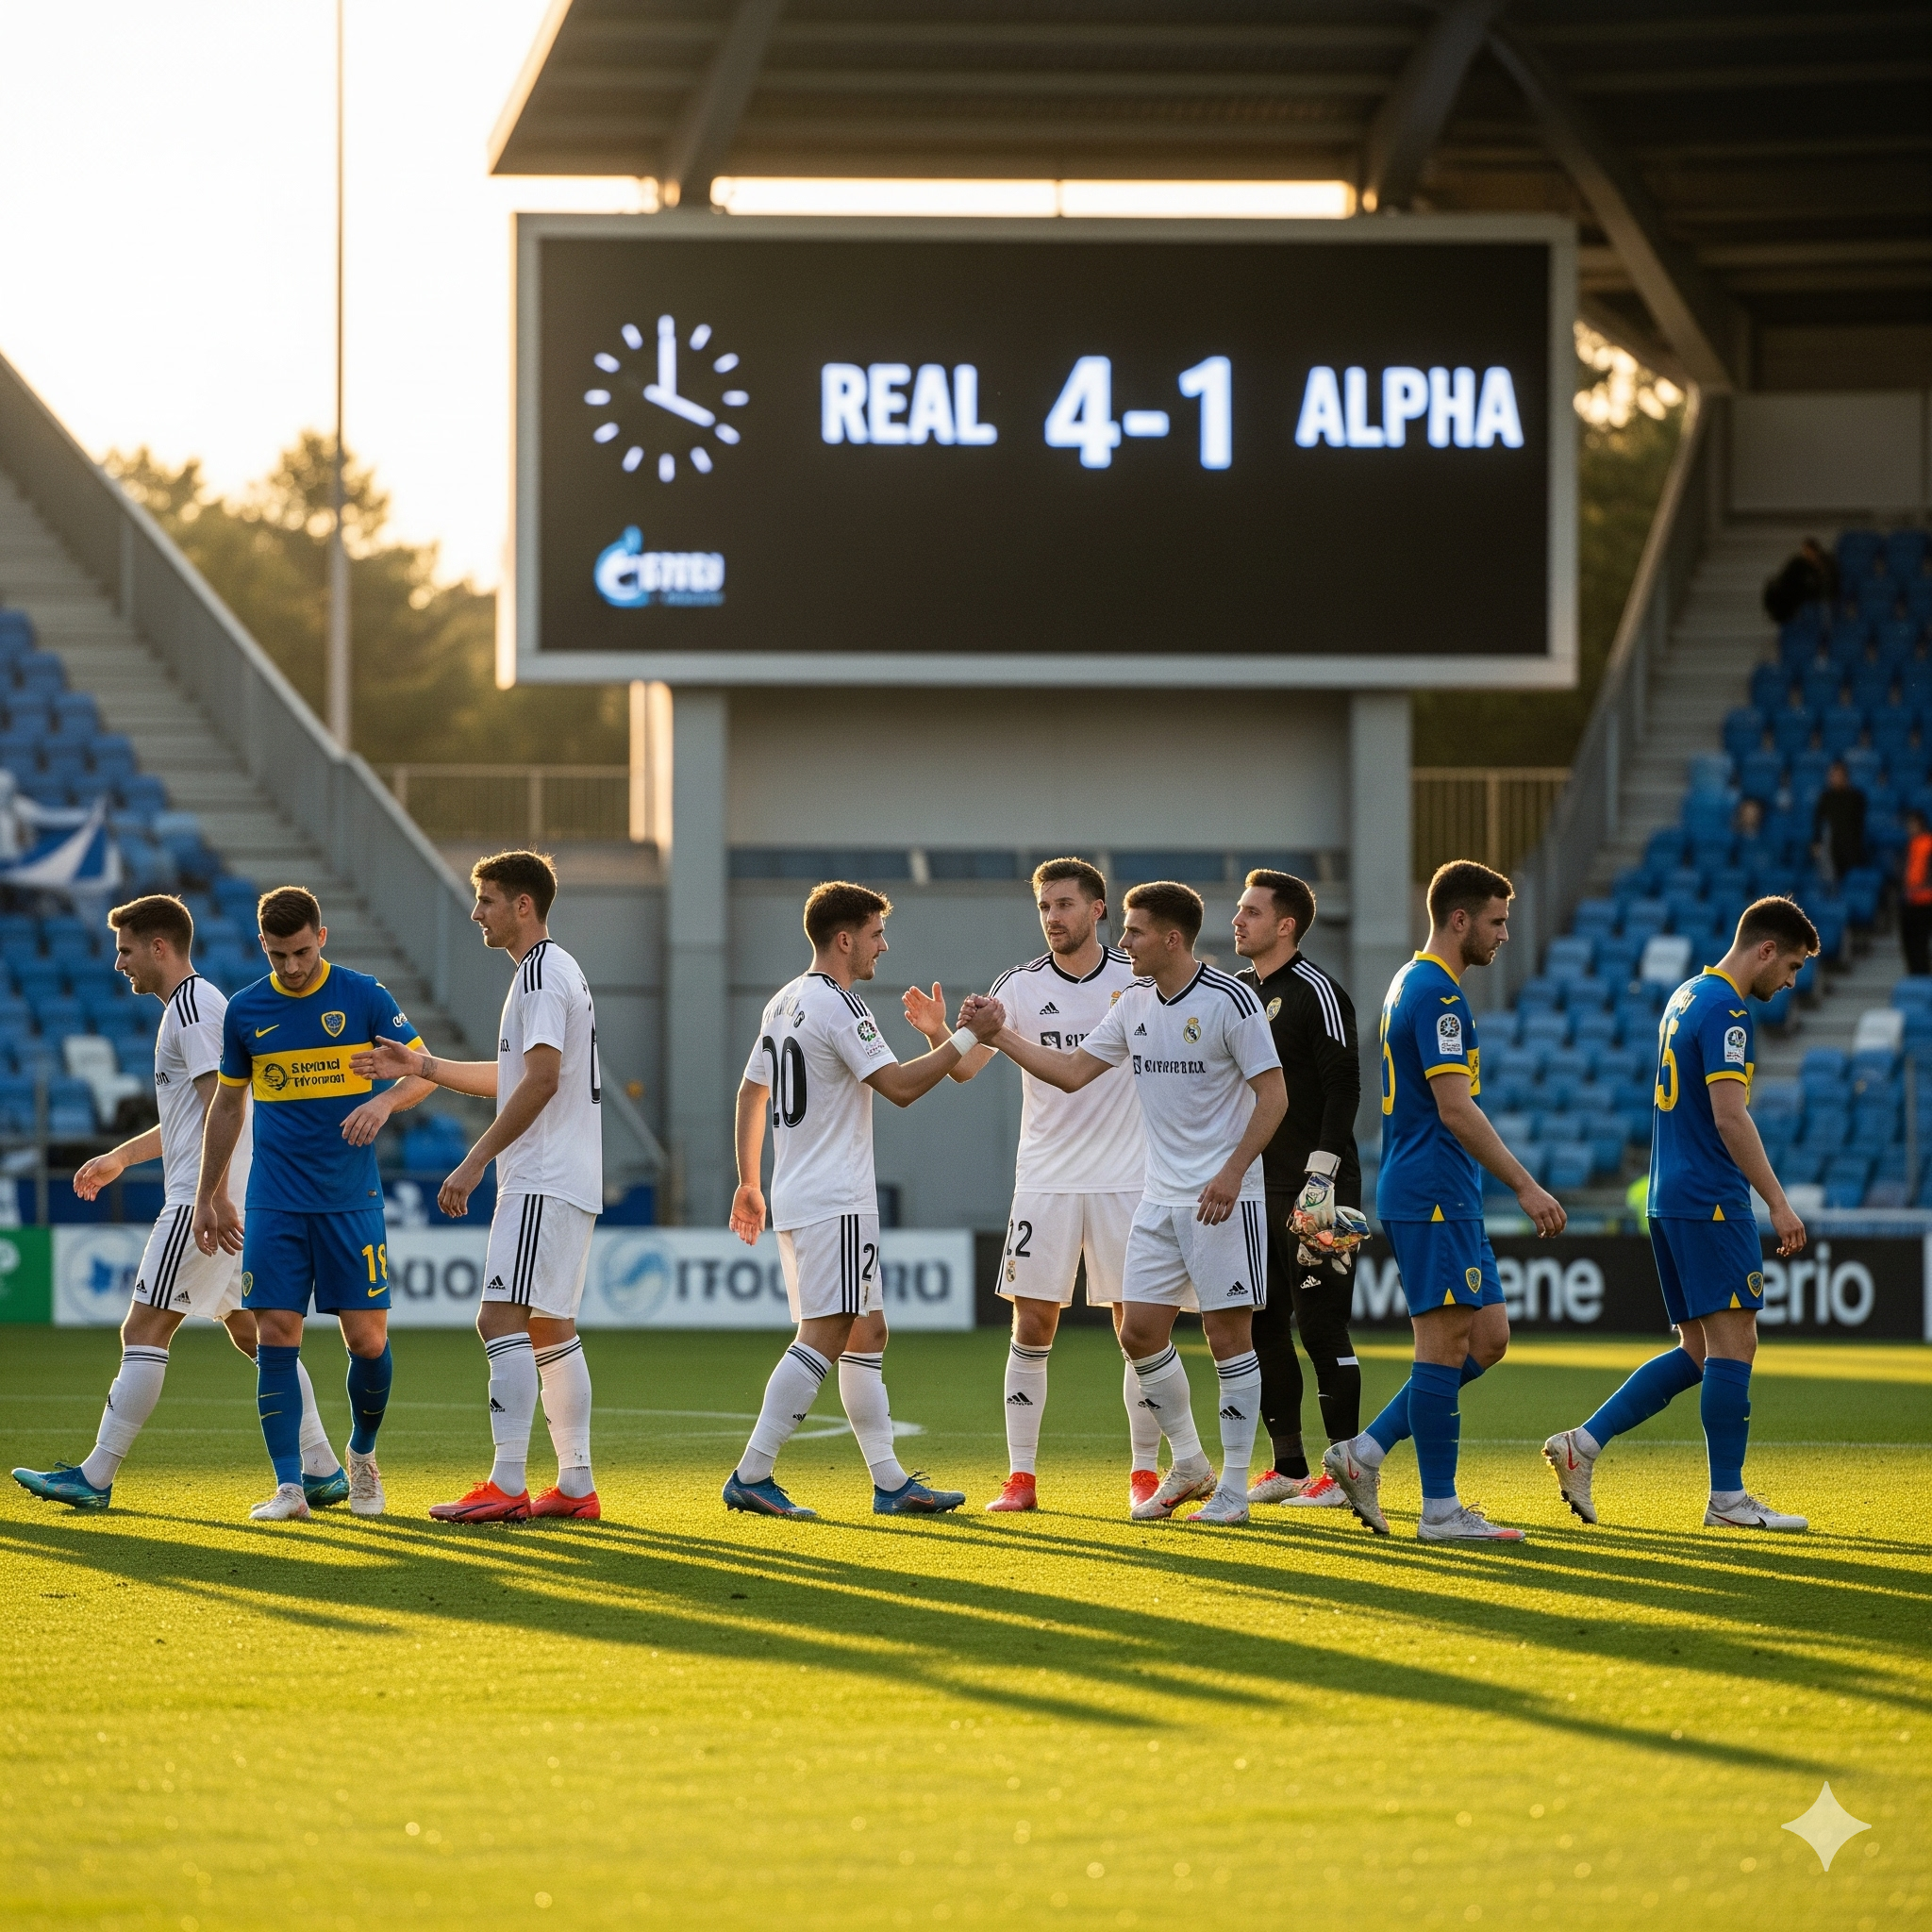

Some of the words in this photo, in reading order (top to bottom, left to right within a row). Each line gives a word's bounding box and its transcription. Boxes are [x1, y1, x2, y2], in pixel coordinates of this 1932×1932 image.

[821, 362, 998, 445] REAL
[1043, 355, 1232, 470] 4-1
[1294, 365, 1524, 448] ALPHA
